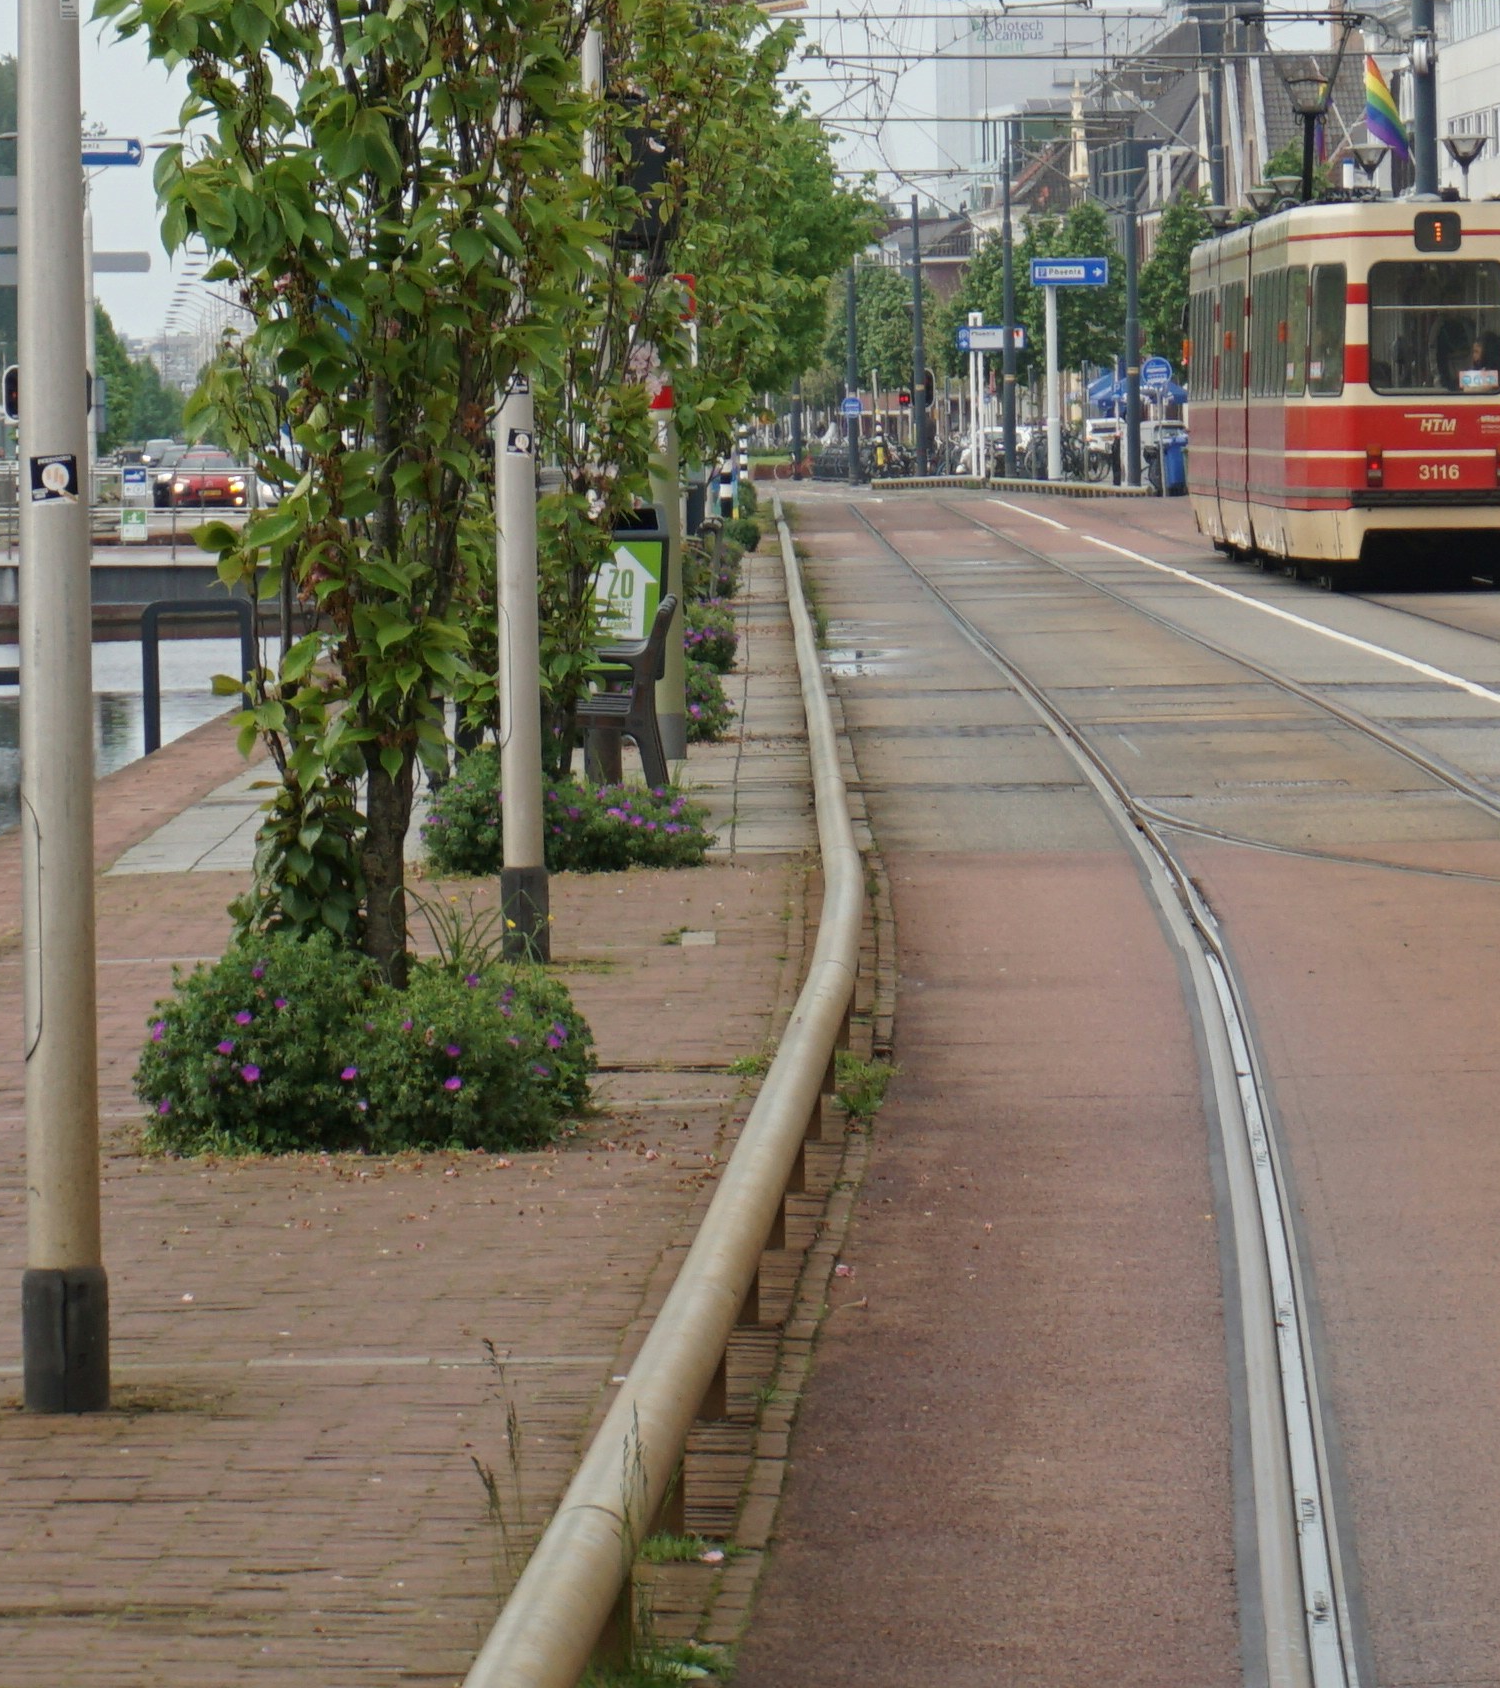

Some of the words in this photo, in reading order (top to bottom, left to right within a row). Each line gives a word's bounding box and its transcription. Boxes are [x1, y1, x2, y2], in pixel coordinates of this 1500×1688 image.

[994, 19, 1044, 31] biotech
[994, 31, 1044, 43] campus
[1420, 418, 1457, 432] HTM
[1418, 464, 1460, 480] 3116
[608, 569, 634, 599] ZO
